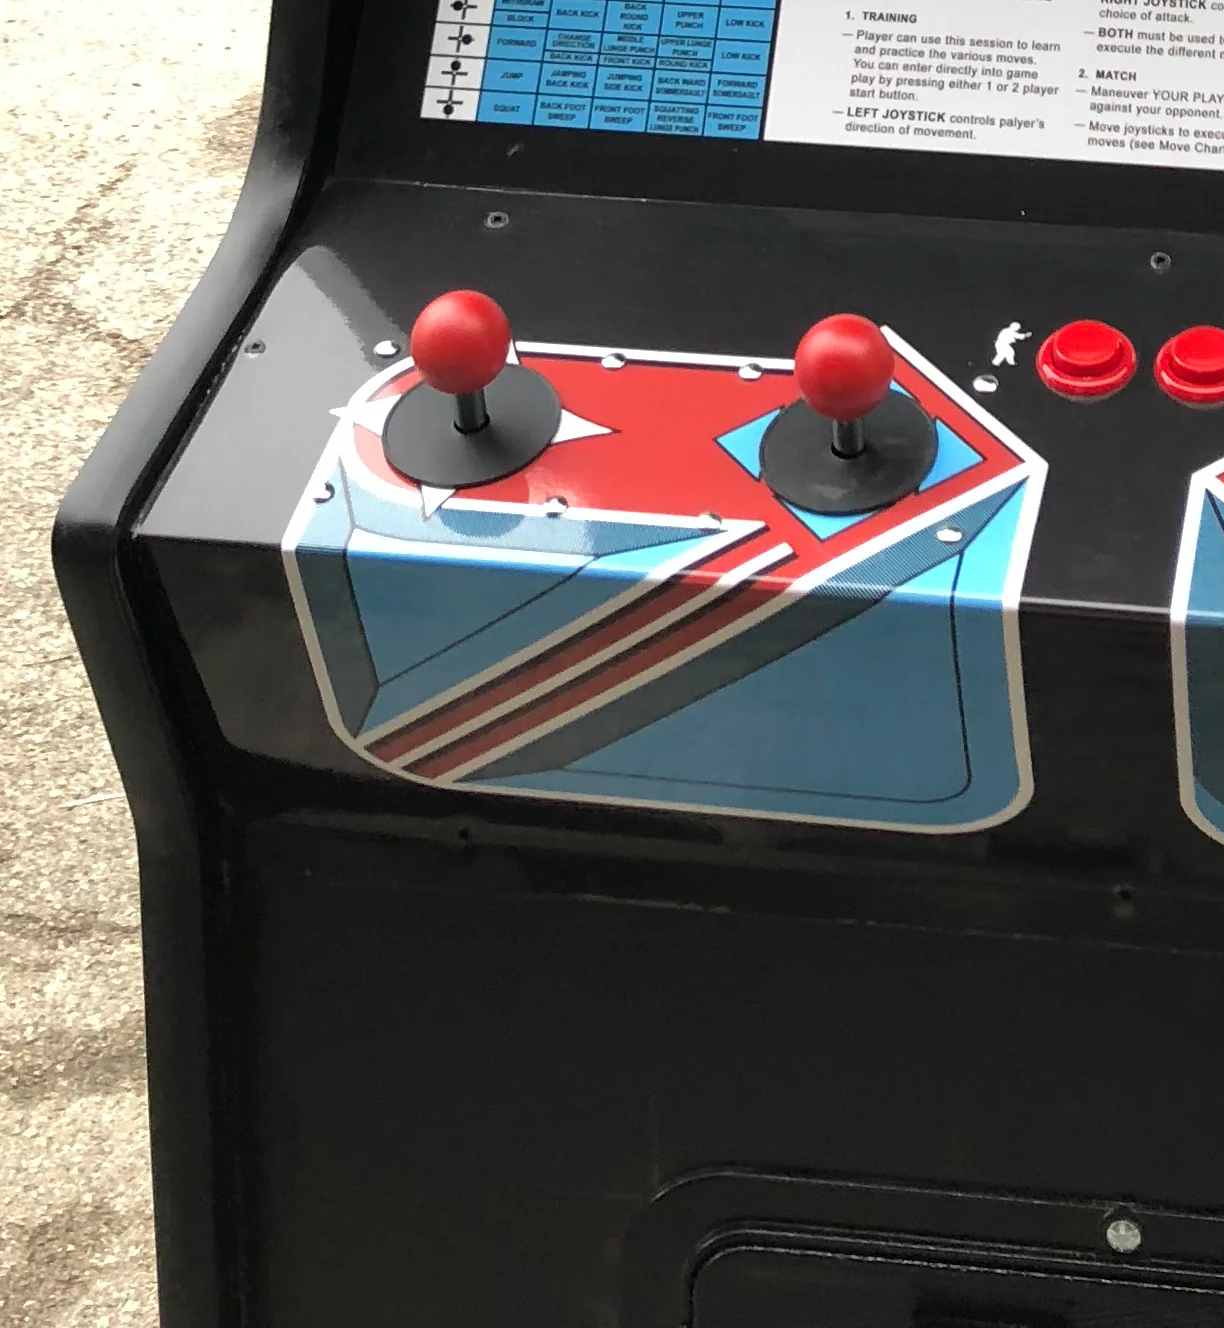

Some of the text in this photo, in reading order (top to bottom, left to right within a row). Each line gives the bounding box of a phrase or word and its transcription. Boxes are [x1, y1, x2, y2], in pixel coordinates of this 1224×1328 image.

[862, 11, 918, 25] TRAINING
[1098, 8, 1137, 20] choice
[1140, 10, 1153, 21] of
[856, 29, 1061, 52] Player can use this session to learn
[1098, 27, 1134, 40] BOTH
[1137, 31, 1166, 42] must
[1168, 31, 1184, 43] be
[1187, 34, 1216, 45] used
[854, 45, 876, 56] and
[879, 47, 925, 59] practice
[928, 48, 947, 60] the
[950, 51, 993, 63] various
[1096, 43, 1142, 55] execute
[1146, 45, 1164, 56] the
[1168, 46, 1216, 60] different
[853, 58, 1039, 81] You can enter directly into game
[1095, 69, 1137, 82] MATCH
[849, 88, 876, 99] start
[850, 73, 1060, 97] play by pressing either 1 or 2 player
[1090, 85, 1149, 100] Maneuver
[1152, 89, 1189, 103] YOUR
[846, 106, 880, 119] LEFT
[882, 108, 946, 123] JOYSTICK
[949, 115, 996, 126] controls
[1089, 102, 1132, 114] against
[1136, 105, 1162, 117] your
[844, 121, 895, 134] direction
[898, 124, 911, 135] of
[1088, 120, 1121, 133] Move
[1123, 124, 1175, 137] joysticks
[1178, 127, 1190, 138] to
[1087, 137, 1126, 148] moves
[1159, 140, 1191, 153] Move
